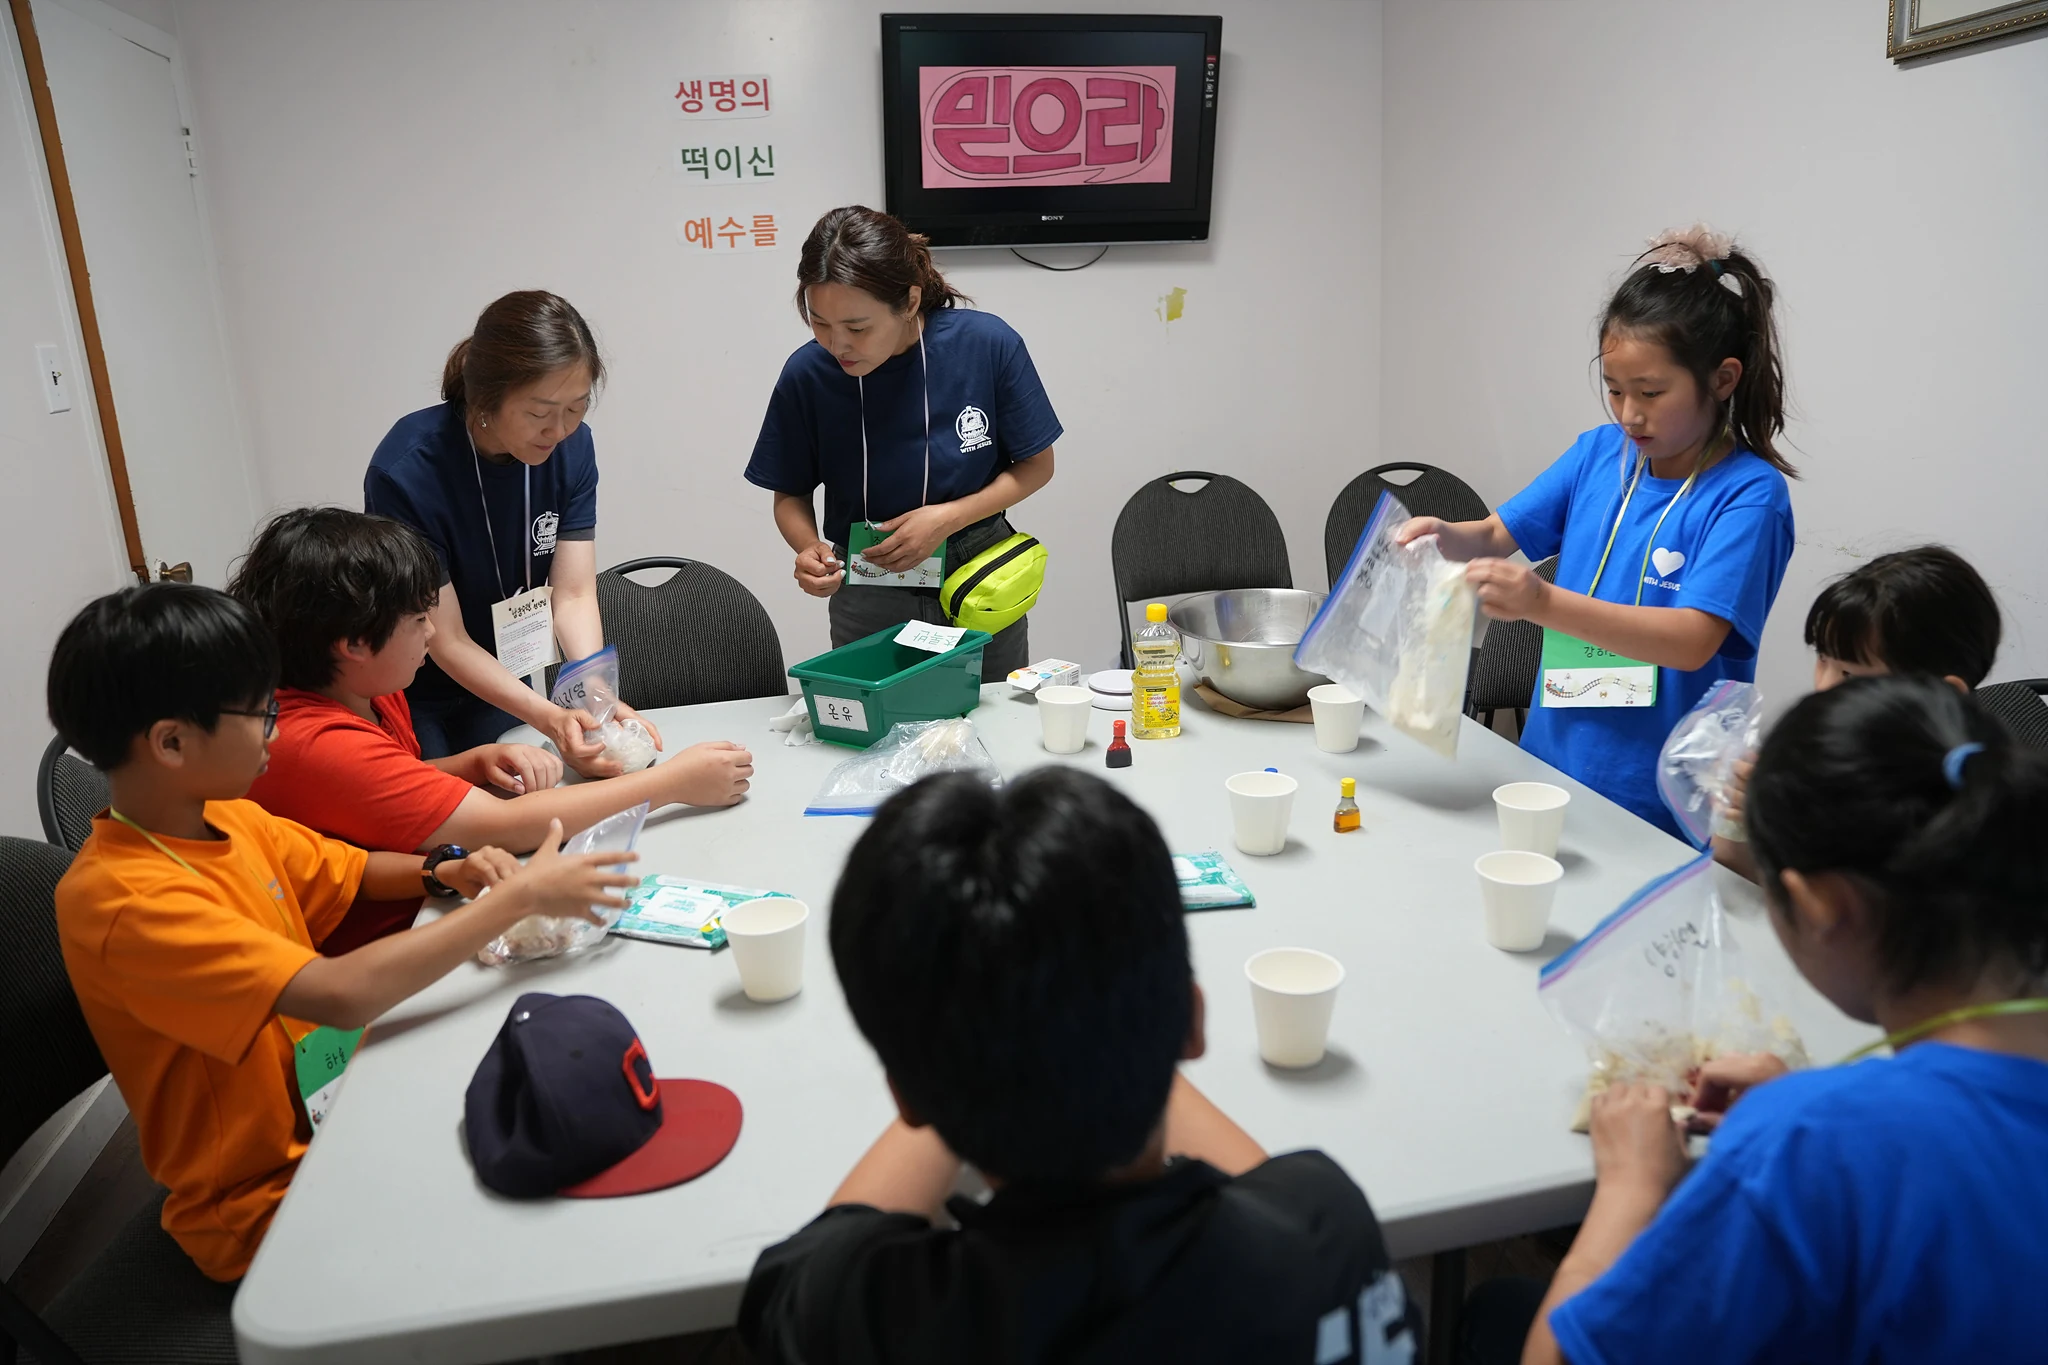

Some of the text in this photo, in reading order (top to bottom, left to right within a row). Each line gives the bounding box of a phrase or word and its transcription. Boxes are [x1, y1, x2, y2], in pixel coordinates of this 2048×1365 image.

[674, 78, 769, 113] 생명의
[933, 75, 1165, 174] 믿으라
[681, 145, 775, 179] 떡이신
[684, 214, 779, 249] 예수를
[960, 440, 993, 454] WITH JESUS
[1659, 580, 1681, 591] JESUS
[828, 703, 853, 722] 온유
[622, 1036, 659, 1111] C
